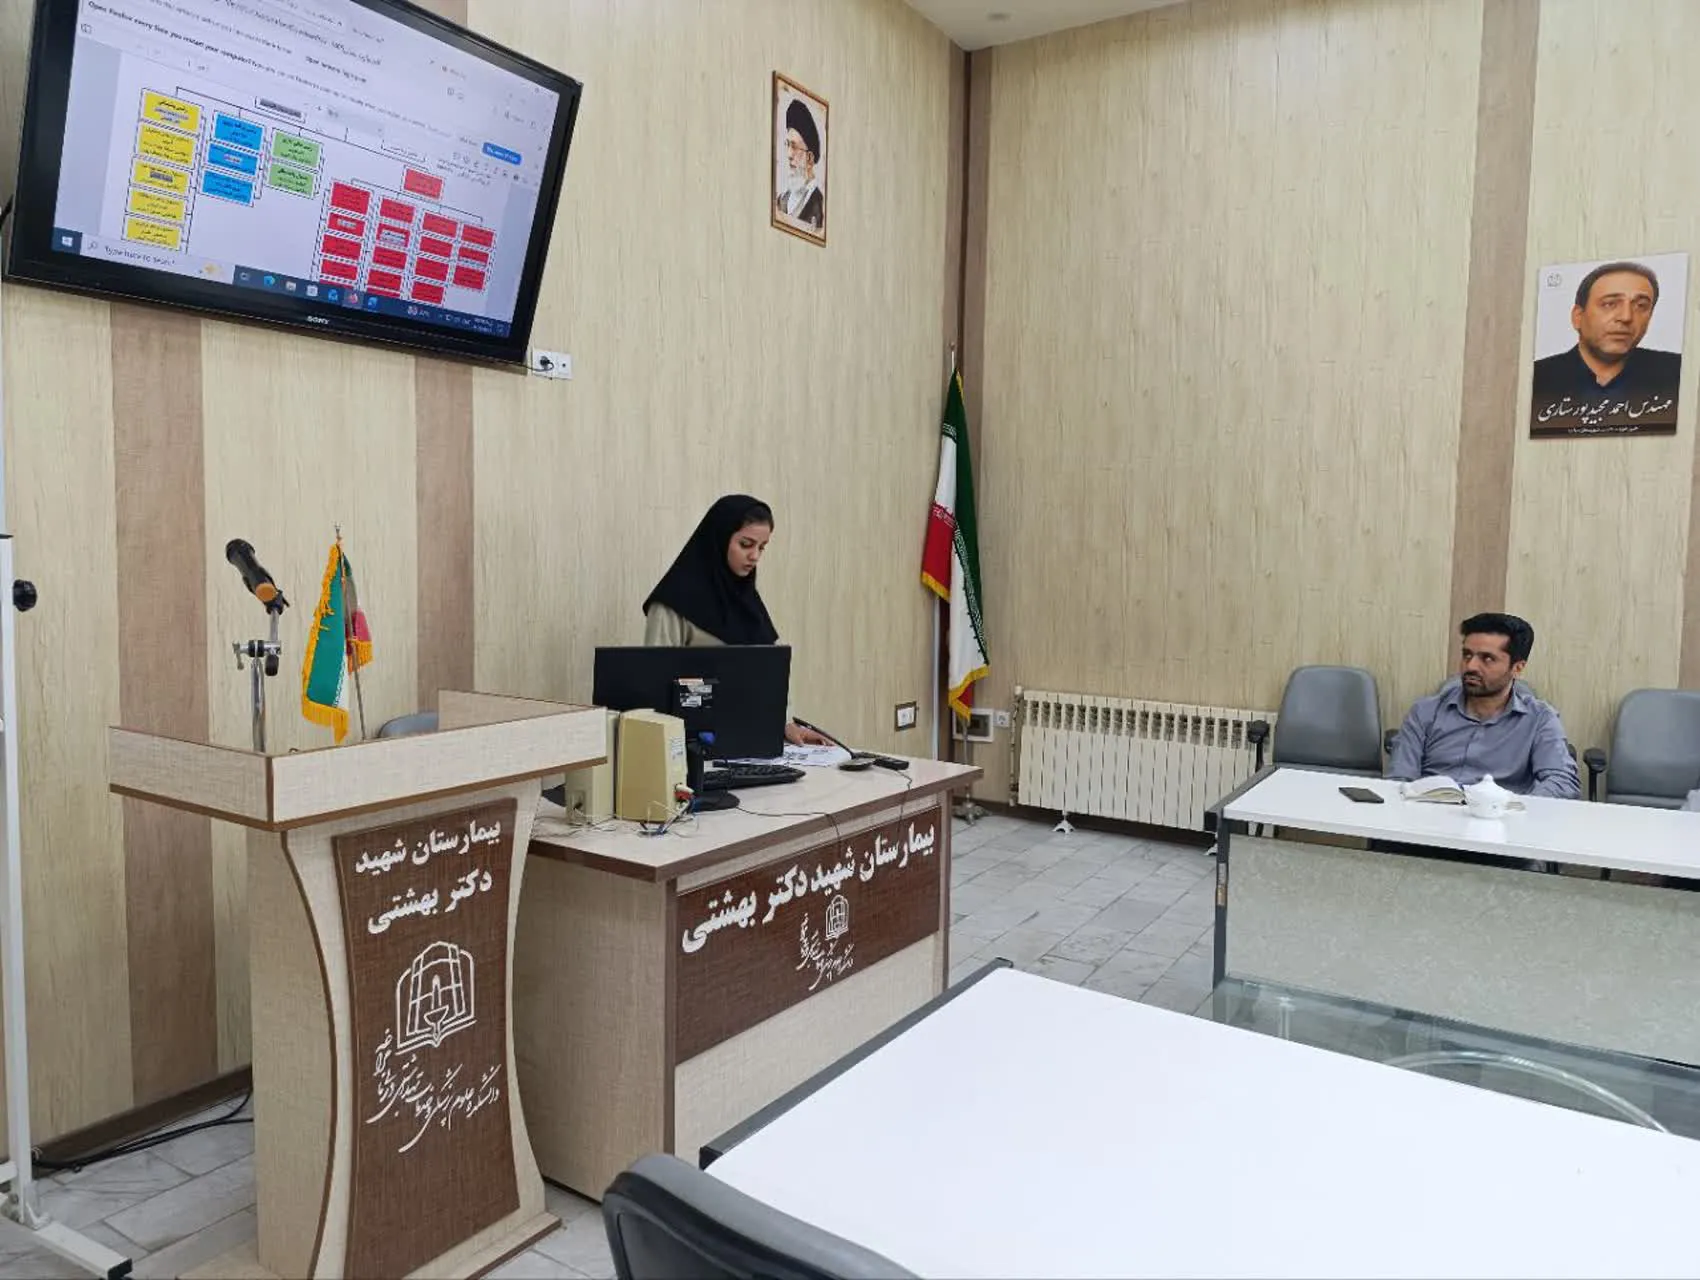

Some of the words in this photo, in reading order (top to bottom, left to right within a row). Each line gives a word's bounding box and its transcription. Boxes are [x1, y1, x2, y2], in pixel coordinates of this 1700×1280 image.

[307, 315, 329, 325] SONY
[355, 838, 407, 876] شهید
[412, 820, 500, 866] بیمارستان
[859, 822, 935, 882] بیمارستان
[444, 868, 493, 912] دکتر
[762, 864, 808, 924] دکتر
[811, 847, 855, 896] شهید
[368, 887, 439, 934] بهشتی
[682, 889, 757, 953] بهشتی
